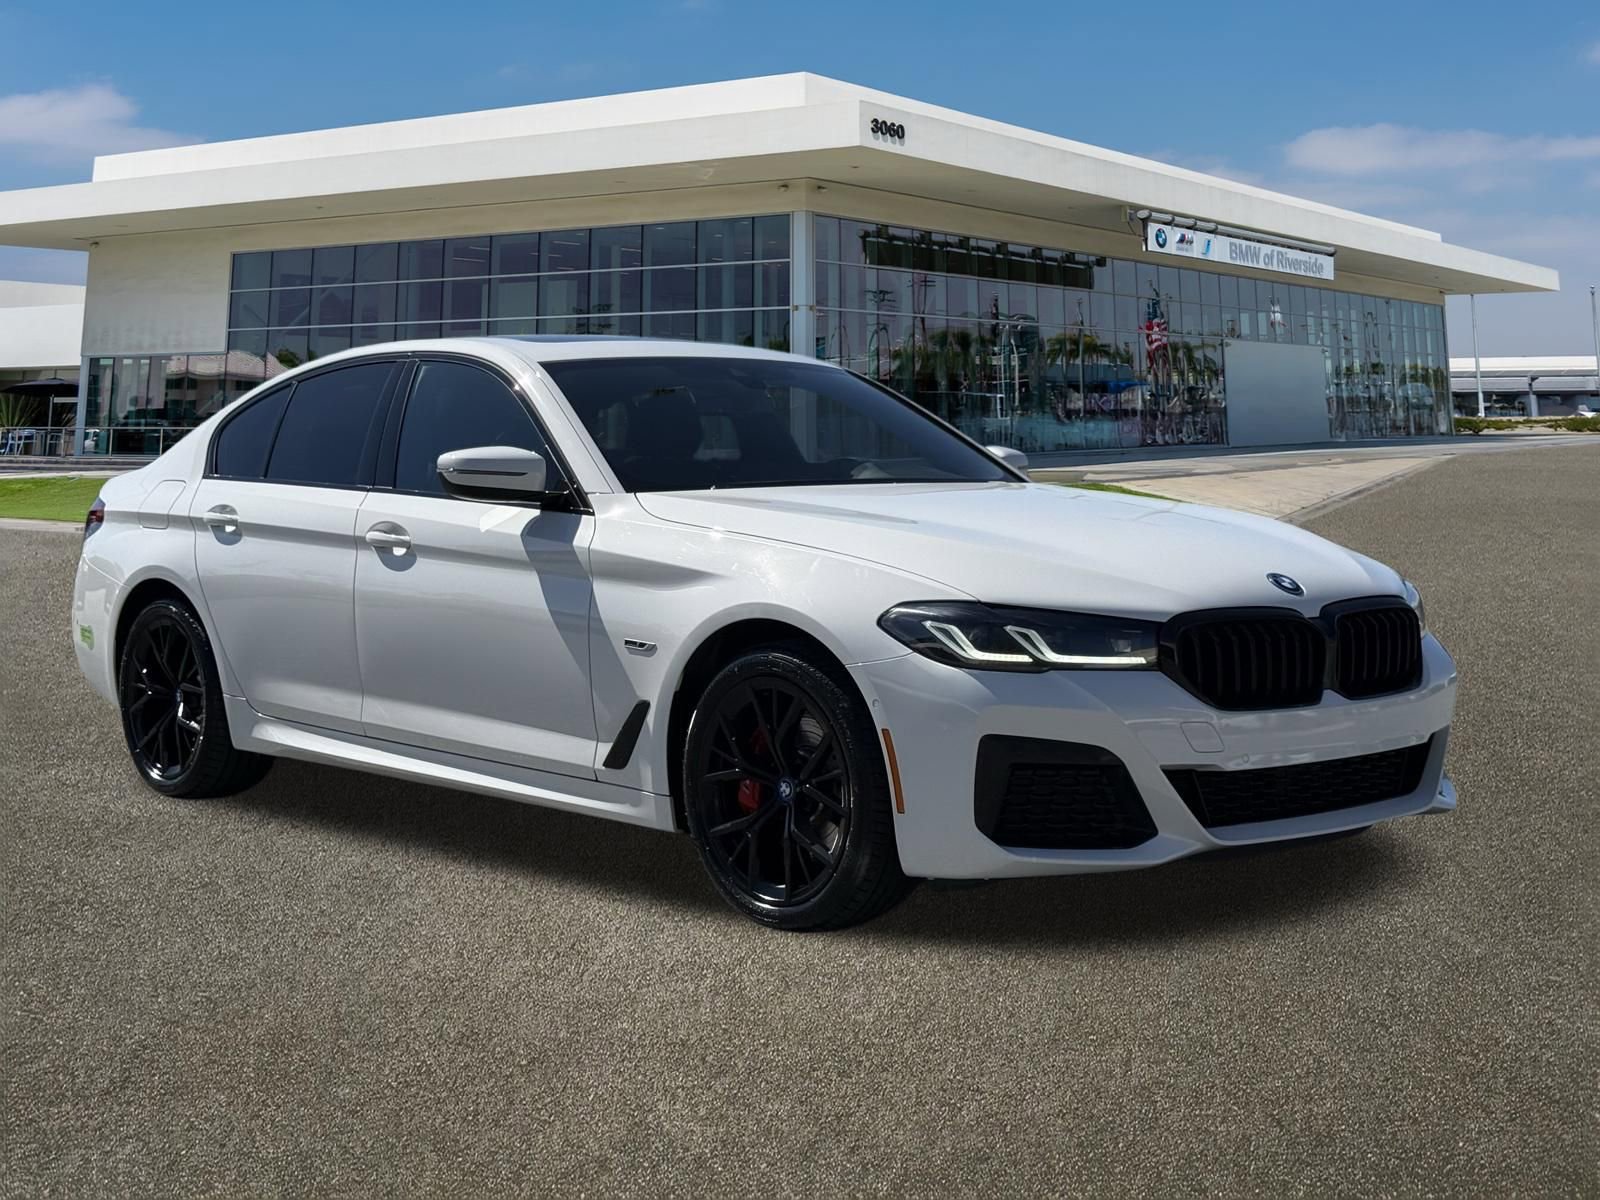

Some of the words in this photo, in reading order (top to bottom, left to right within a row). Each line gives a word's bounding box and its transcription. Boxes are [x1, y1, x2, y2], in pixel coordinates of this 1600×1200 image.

[870, 118, 905, 139] 3060
[1229, 242, 1261, 265] BMW
[1263, 249, 1275, 267] of
[1276, 250, 1324, 275] Riverside
